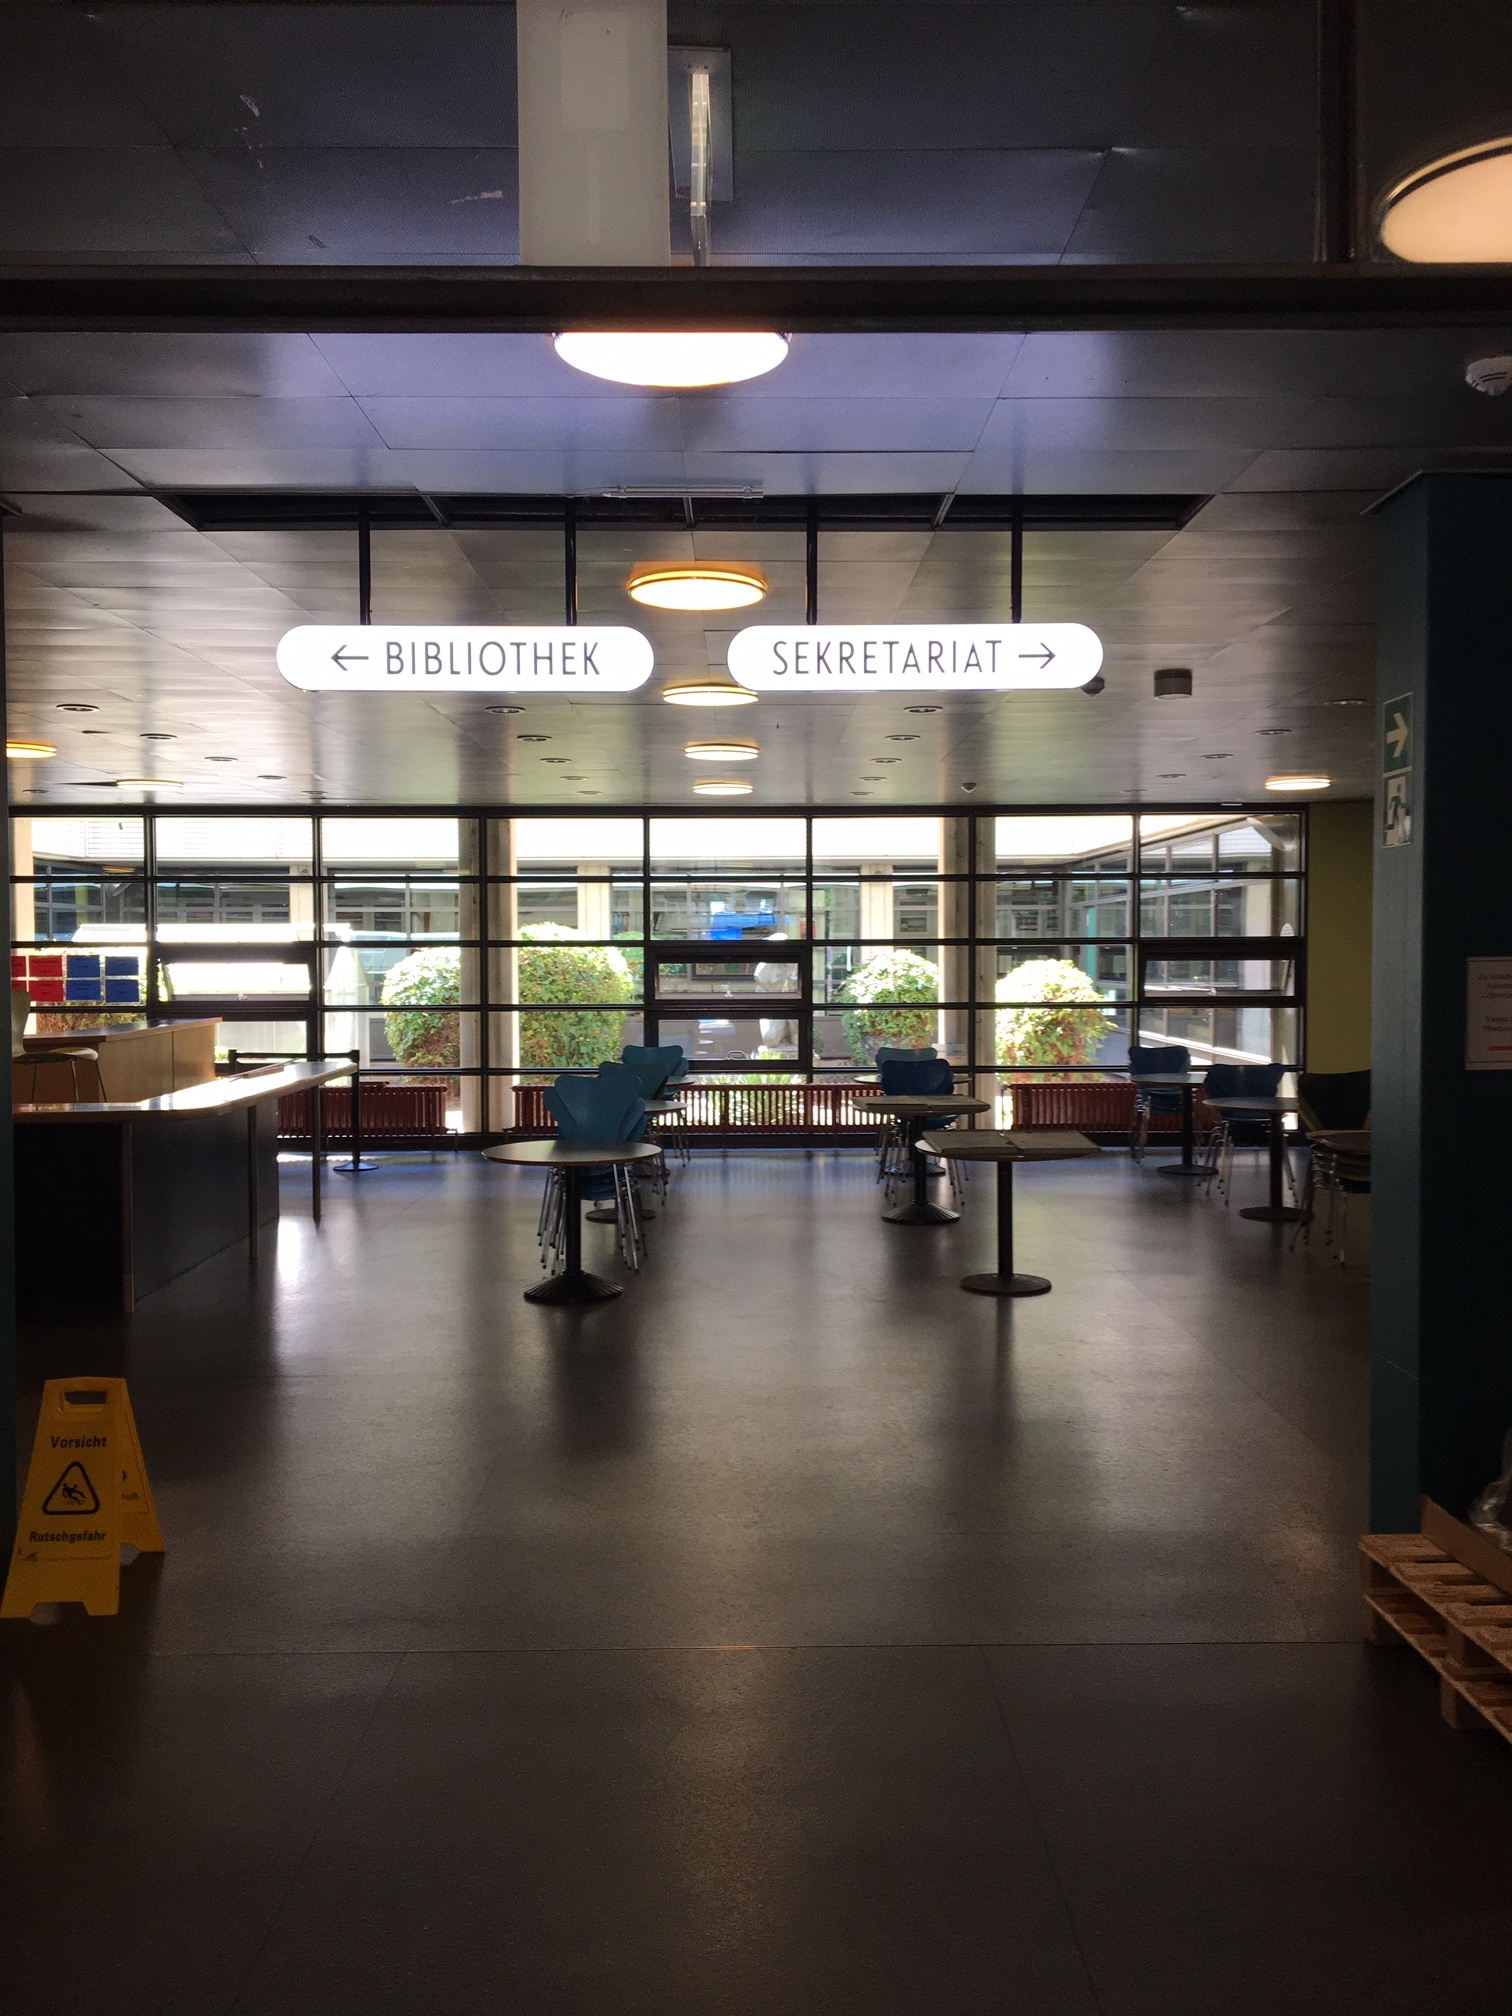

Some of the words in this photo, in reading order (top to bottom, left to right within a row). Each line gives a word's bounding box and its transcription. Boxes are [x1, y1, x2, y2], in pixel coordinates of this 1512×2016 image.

[386, 641, 600, 676] BIBLIOTHEK
[772, 640, 1003, 676] SEKRETARIAT
[50, 1435, 107, 1449] Vorsicht
[29, 1530, 107, 1543] Rutschgefahr
